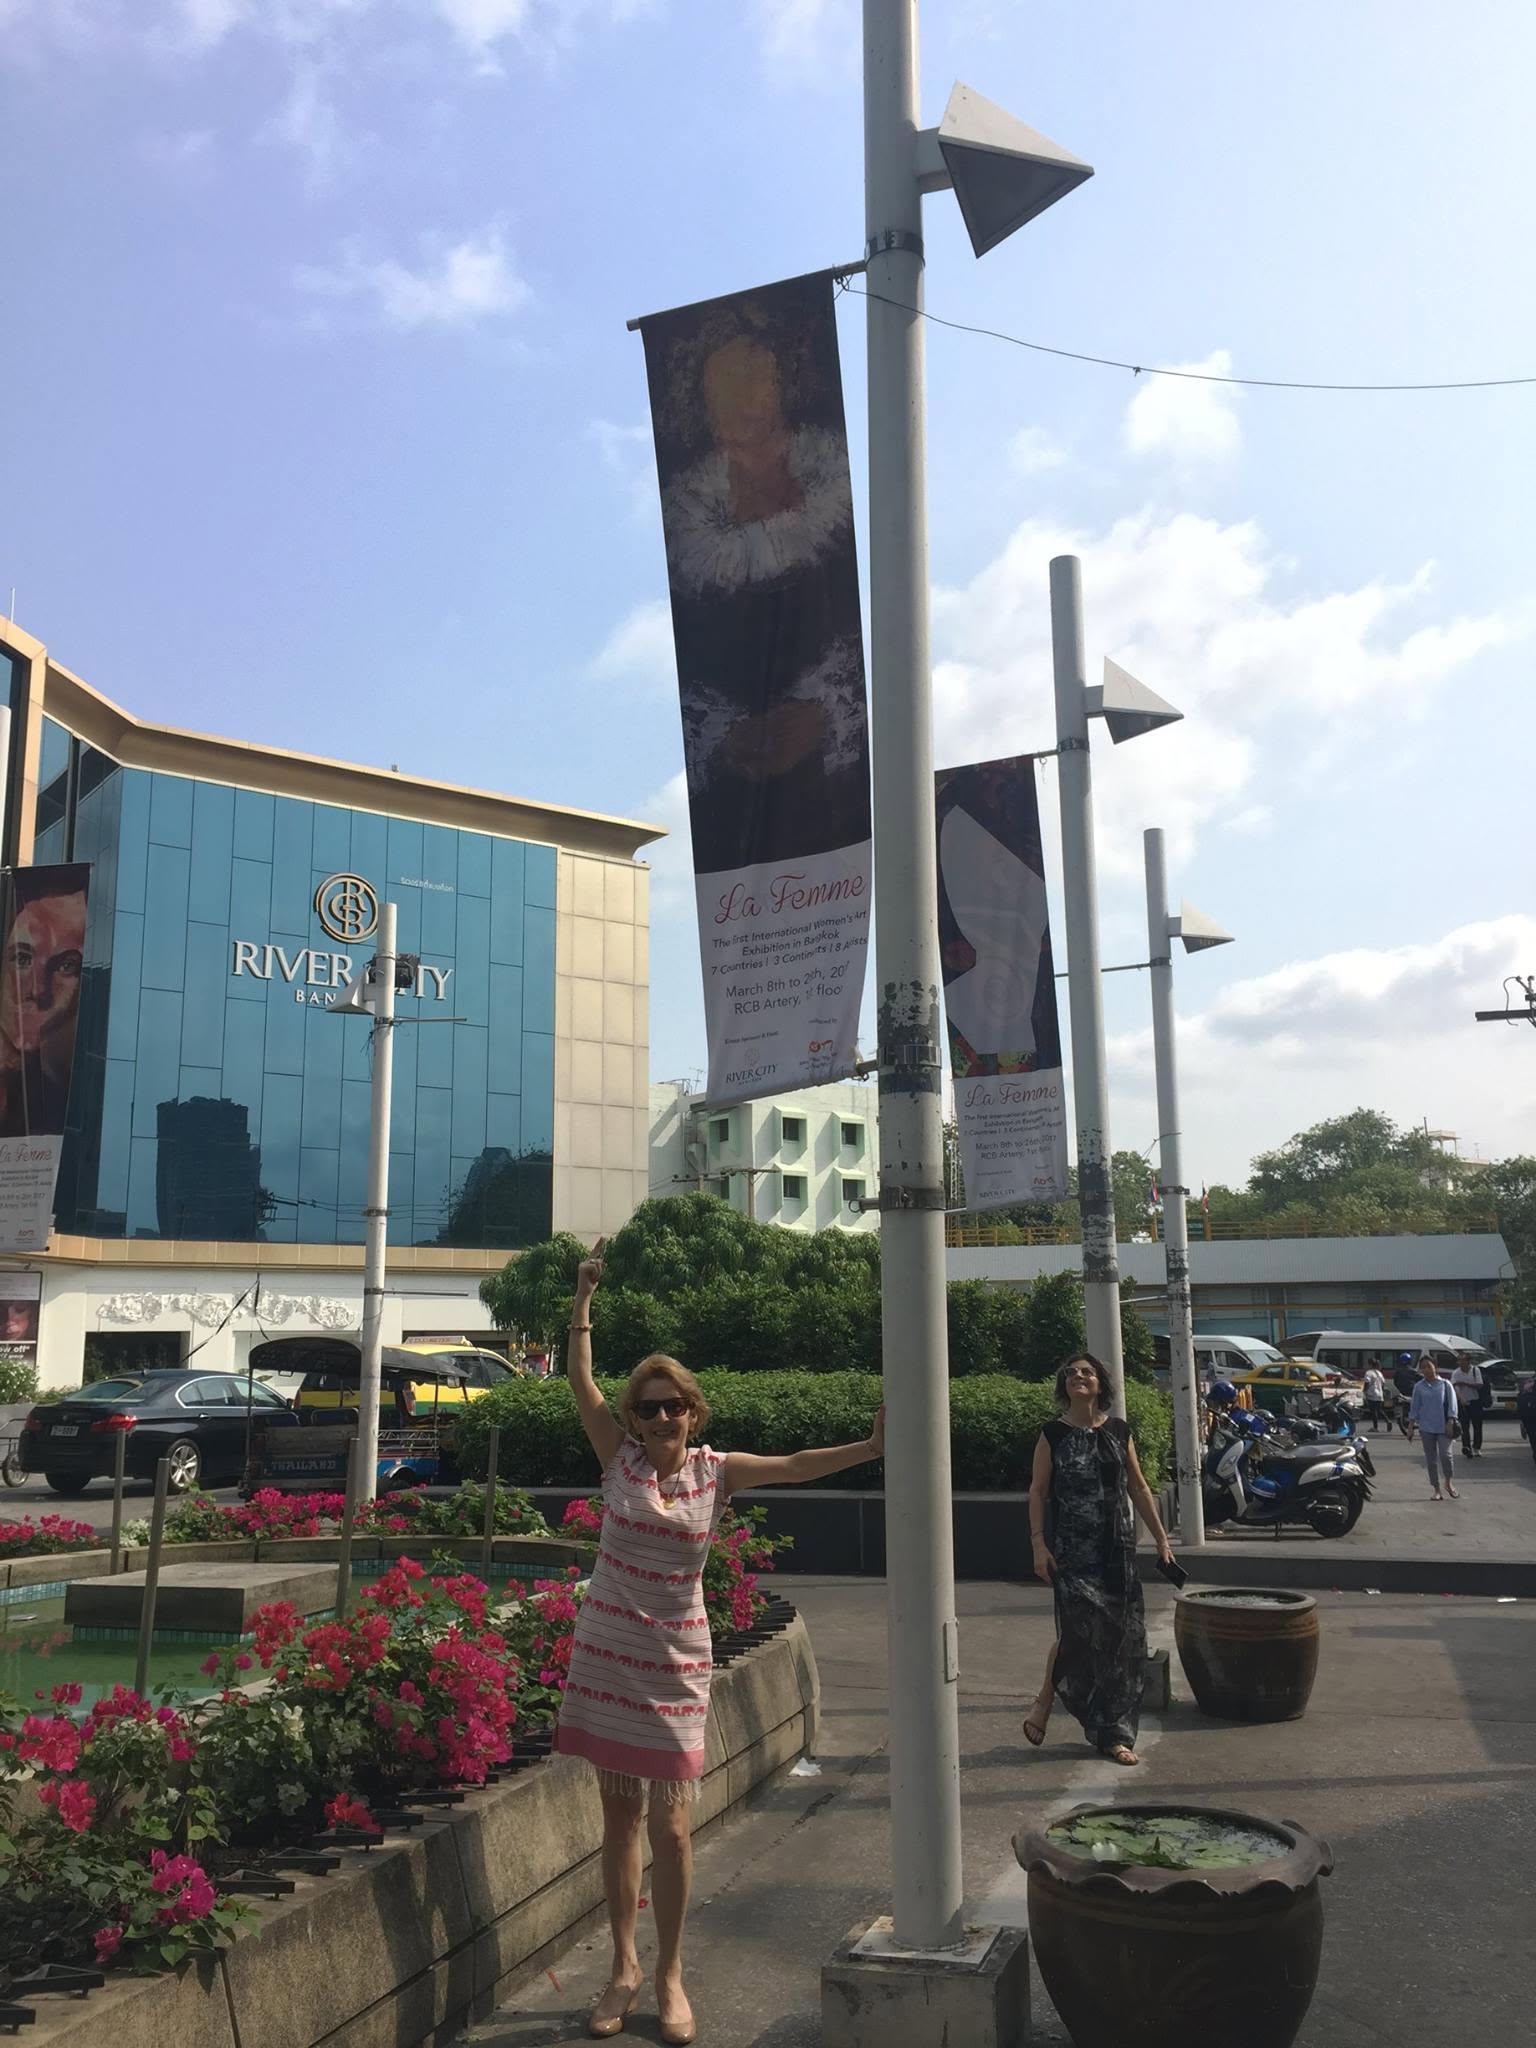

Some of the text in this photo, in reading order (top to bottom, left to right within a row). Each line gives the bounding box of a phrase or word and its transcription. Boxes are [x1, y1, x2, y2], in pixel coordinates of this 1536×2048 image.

[714, 873, 866, 924] La Femme
[712, 938, 731, 949] The
[751, 923, 812, 941] International
[742, 943, 791, 957] Exhibition
[793, 939, 801, 948] in
[232, 940, 353, 987] RIVER
[711, 966, 718, 975] 7
[720, 960, 763, 975] Countries
[774, 955, 780, 965] 3
[726, 982, 764, 998] March
[767, 979, 786, 992] 8th
[789, 978, 801, 988] to
[735, 1000, 760, 1015] RCB
[726, 1069, 754, 1083] RIVER
[755, 1063, 778, 1077] CITY
[964, 1082, 1059, 1108] La Femme
[271, 1460, 336, 1471] THAILAND
